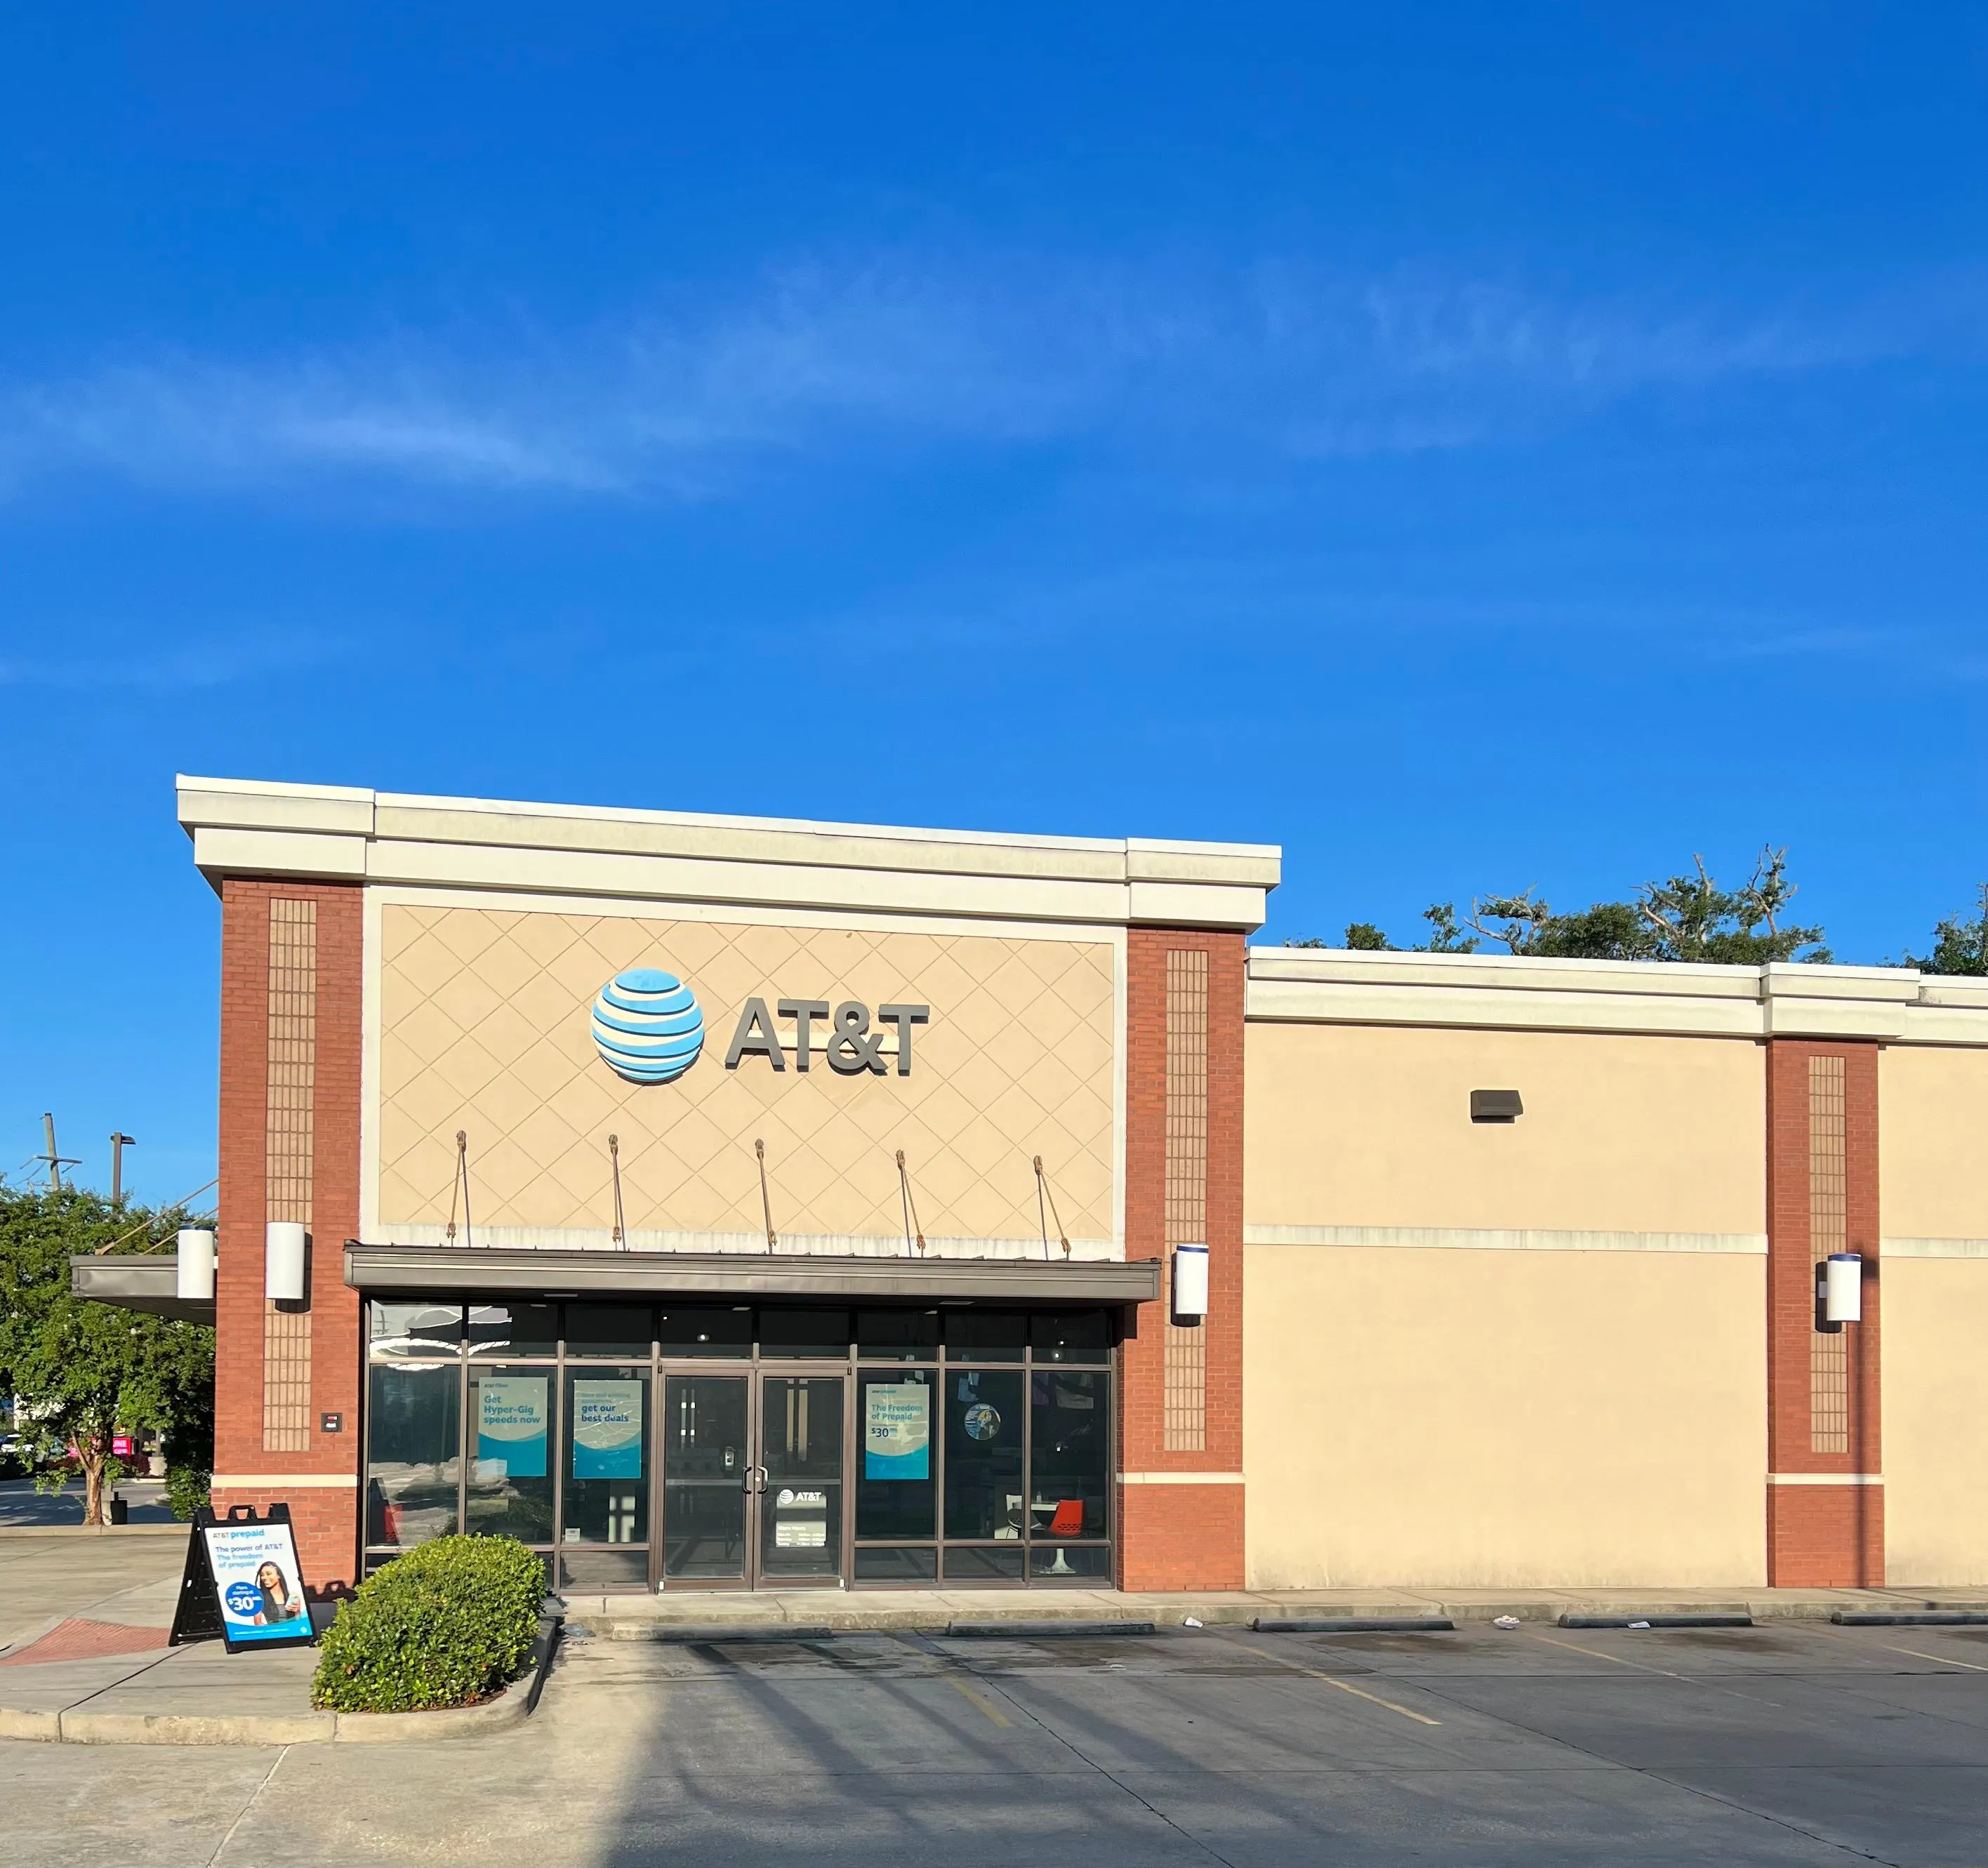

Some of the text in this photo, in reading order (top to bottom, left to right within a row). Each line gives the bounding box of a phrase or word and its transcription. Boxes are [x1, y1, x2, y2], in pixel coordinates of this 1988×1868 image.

[725, 997, 929, 1075] AT&T
[484, 1405, 534, 1415] Hyper-Gig
[582, 1405, 597, 1414] get
[483, 1415, 517, 1425] speeds
[882, 1412, 913, 1421] Prepaid
[871, 1428, 889, 1437] $30
[795, 1492, 822, 1502] AT&T
[230, 1529, 265, 1539] prepaid
[228, 1561, 256, 1570] prepaid
[227, 1596, 254, 1611] $30
